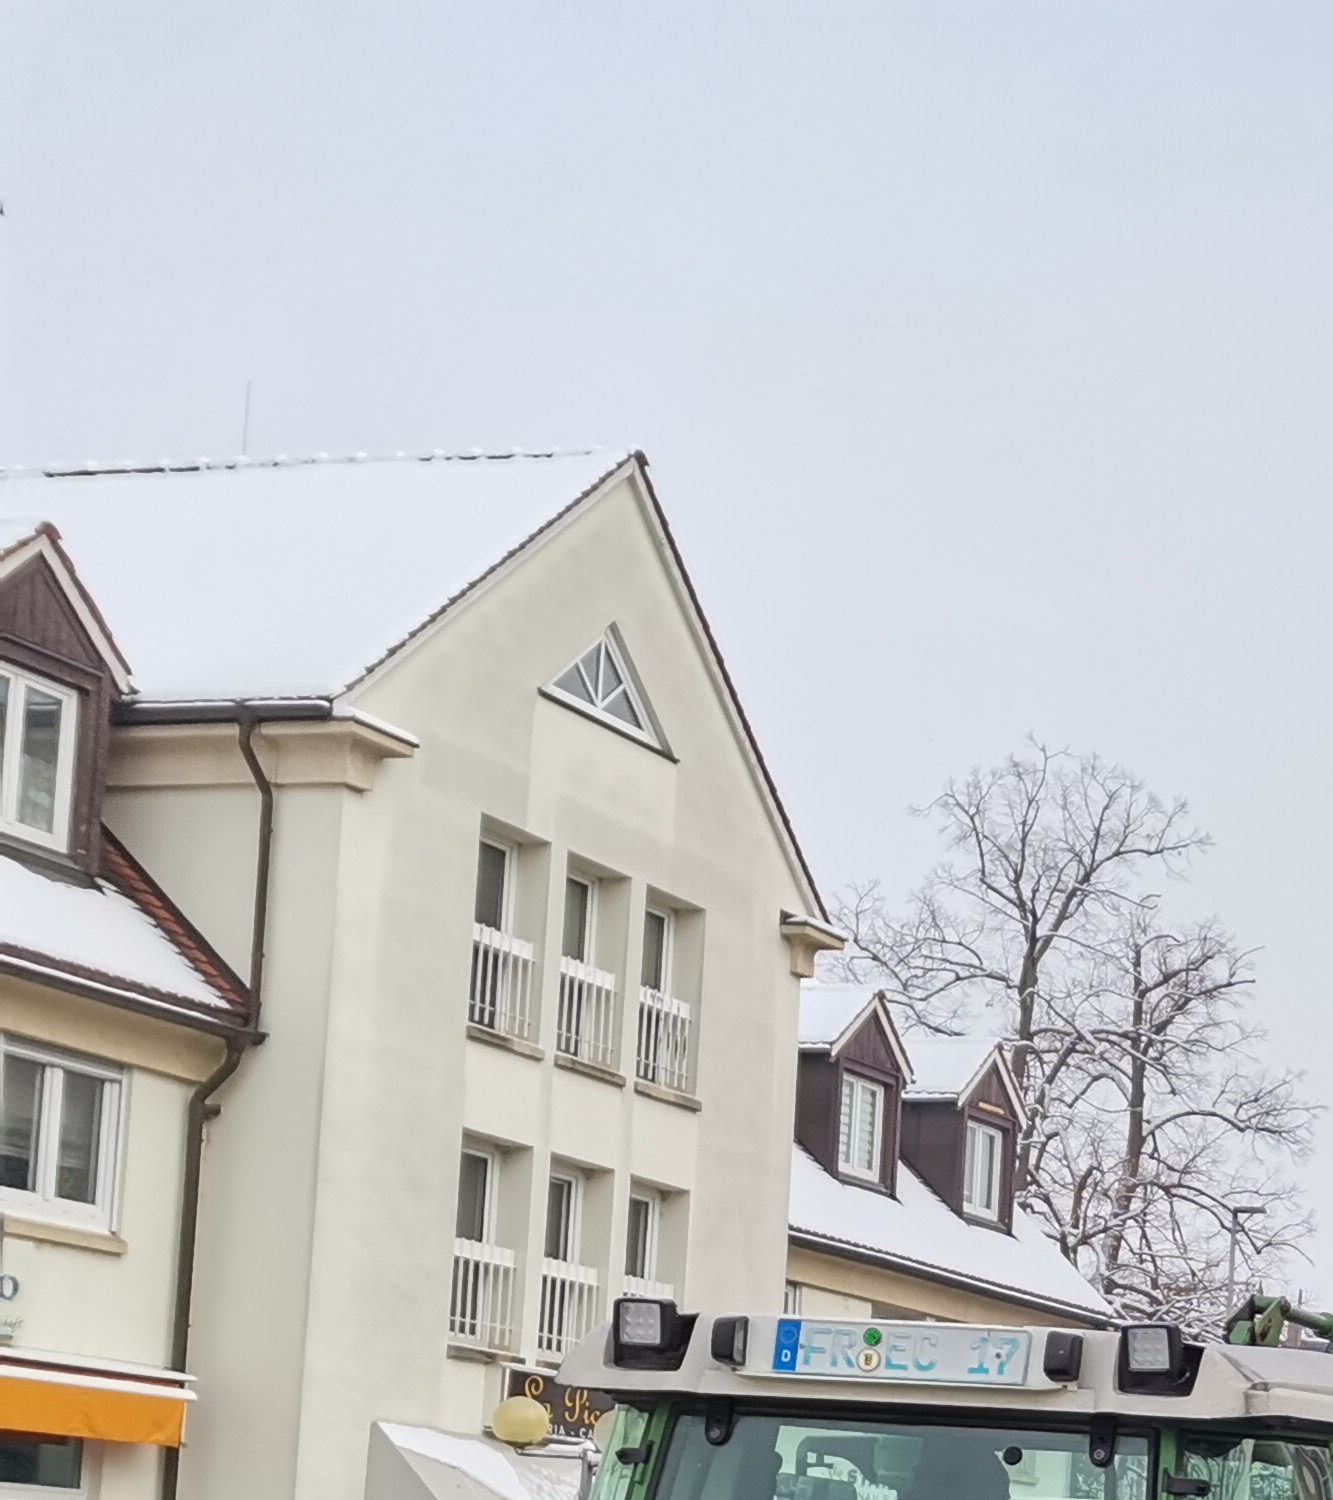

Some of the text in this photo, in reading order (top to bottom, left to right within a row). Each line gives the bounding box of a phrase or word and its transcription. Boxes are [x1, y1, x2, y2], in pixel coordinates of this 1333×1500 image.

[781, 1327, 1021, 1376] D FR EC 17
